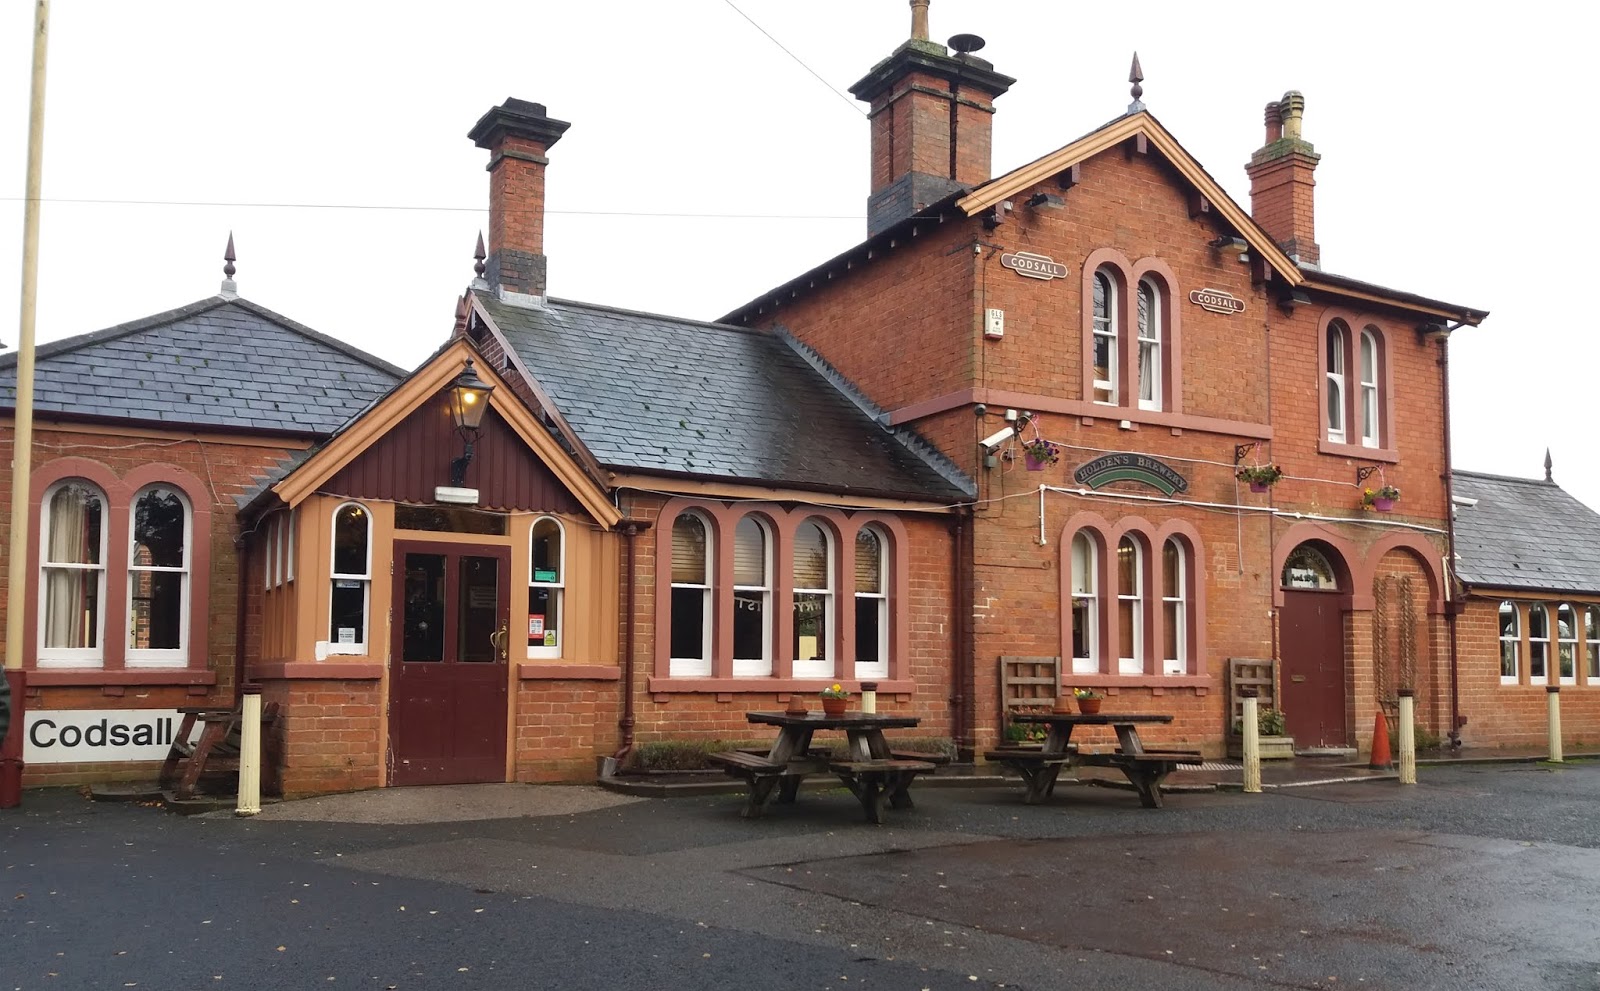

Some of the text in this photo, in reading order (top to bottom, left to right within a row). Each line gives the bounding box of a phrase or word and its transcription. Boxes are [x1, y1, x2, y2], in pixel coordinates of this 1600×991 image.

[1011, 257, 1058, 274] CODSALL
[1197, 294, 1238, 309] CODSALL
[1079, 455, 1188, 488] HOLDEN'S BREWERY
[29, 717, 173, 748] Codsall
